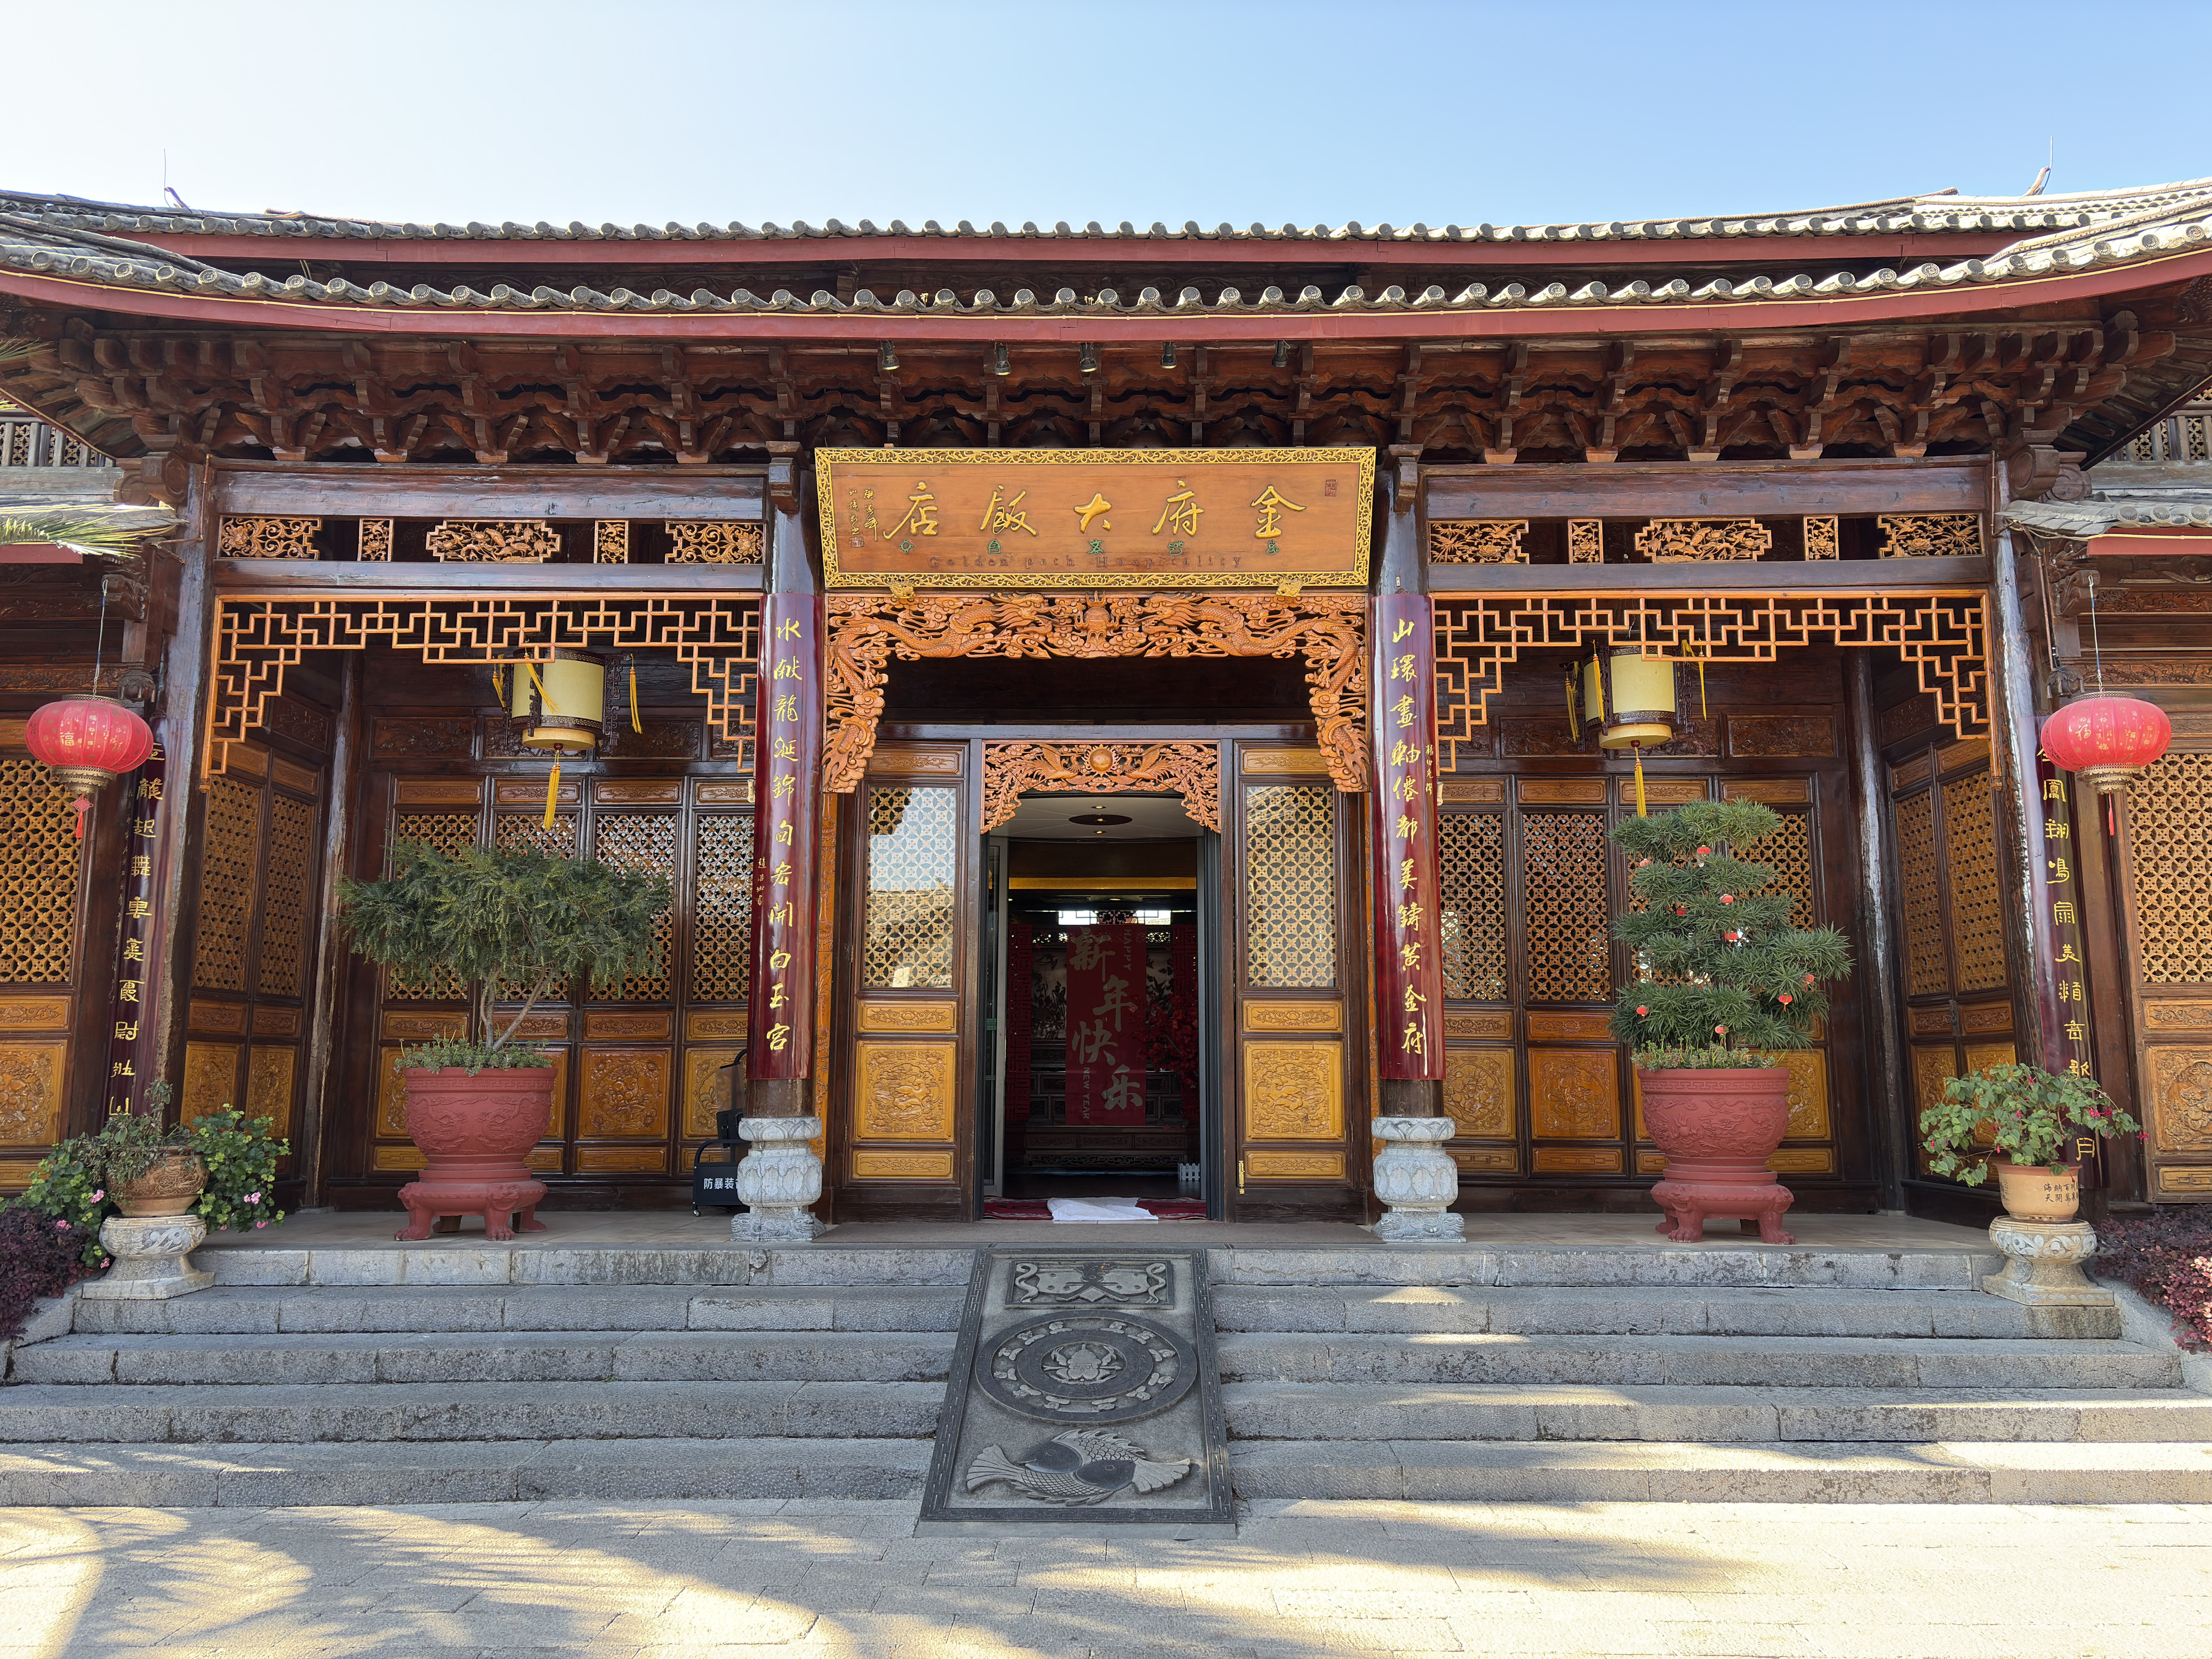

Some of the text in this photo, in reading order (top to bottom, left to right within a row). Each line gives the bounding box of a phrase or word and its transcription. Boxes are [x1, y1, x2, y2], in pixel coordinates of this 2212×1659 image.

[927, 555, 1009, 568] Golden
[1096, 555, 1241, 569] Hospitality
[60, 732, 75, 747] 福
[2075, 724, 2091, 741] 福
[1069, 927, 1143, 1110] 新年快乐
[703, 1177, 738, 1190] 防暴装
